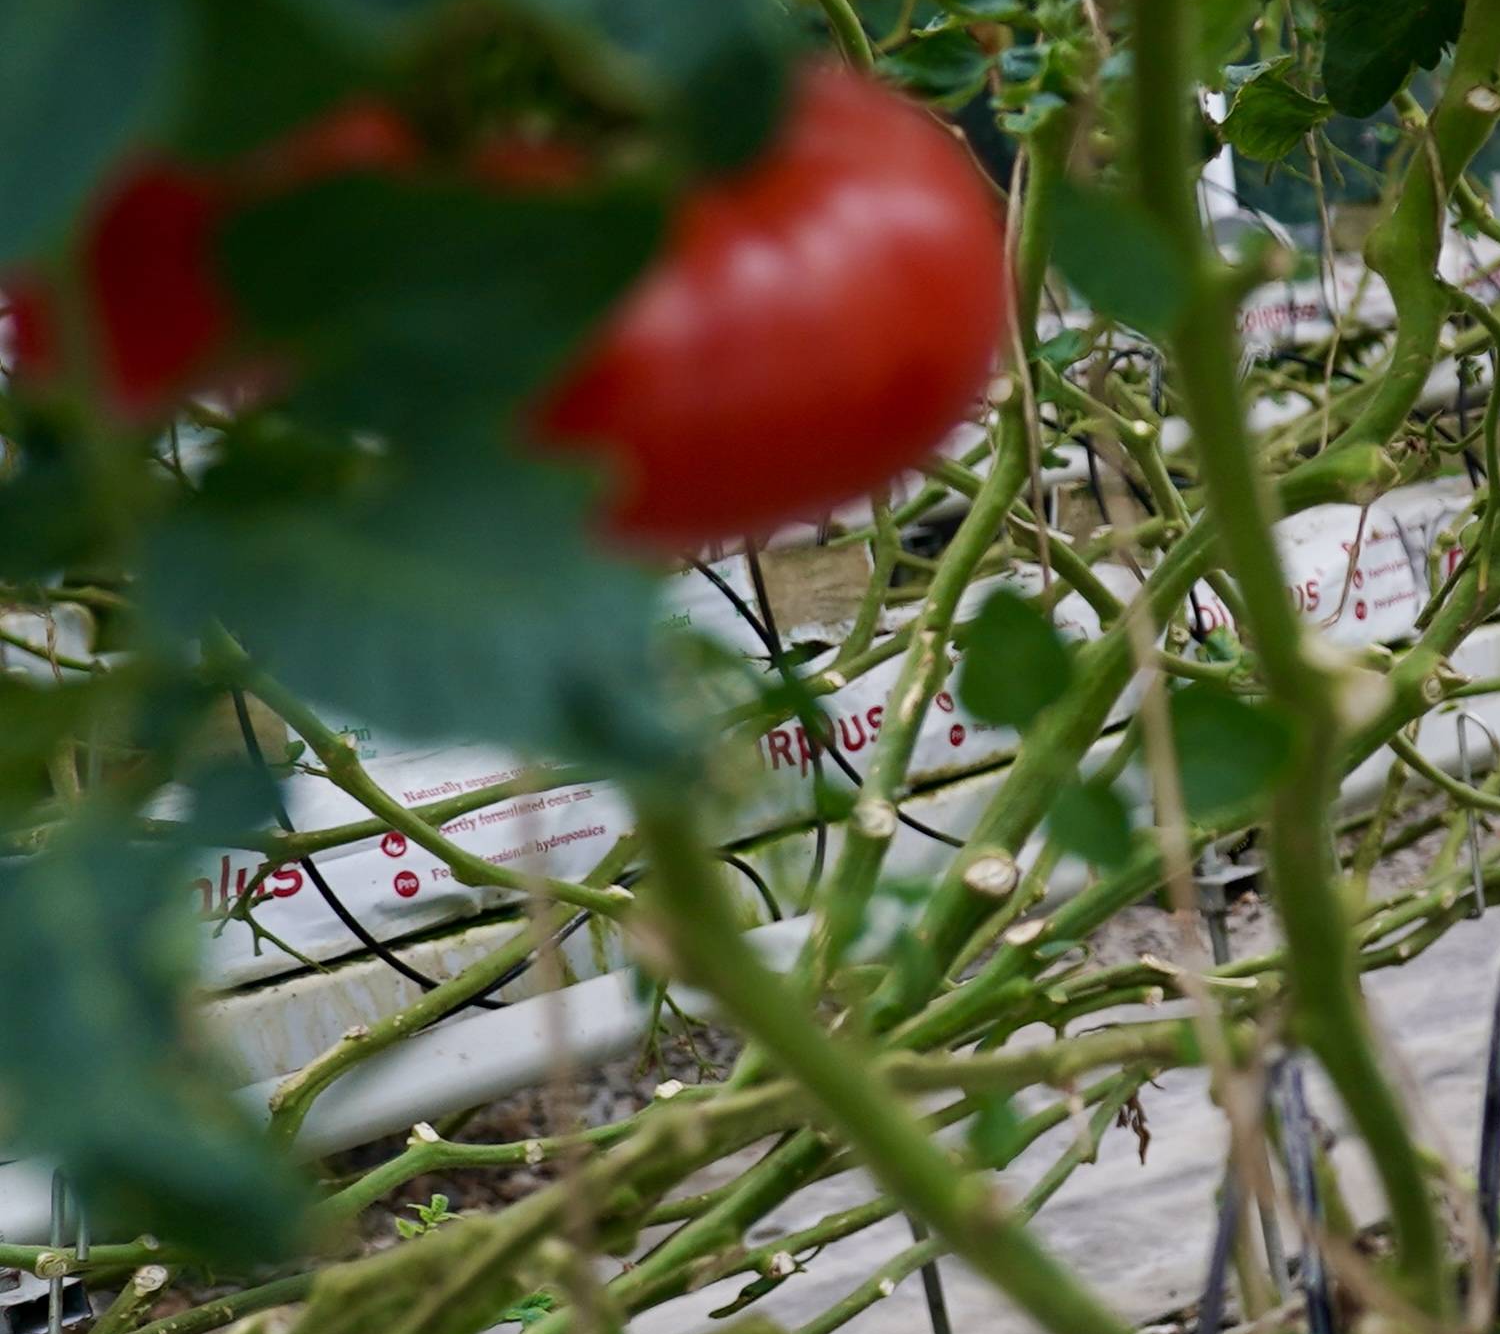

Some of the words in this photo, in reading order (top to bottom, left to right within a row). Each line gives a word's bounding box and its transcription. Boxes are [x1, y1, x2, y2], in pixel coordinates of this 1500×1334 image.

[403, 777, 463, 804] Naturally
[536, 824, 607, 853] hydroponics
[397, 877, 418, 890] Pro
